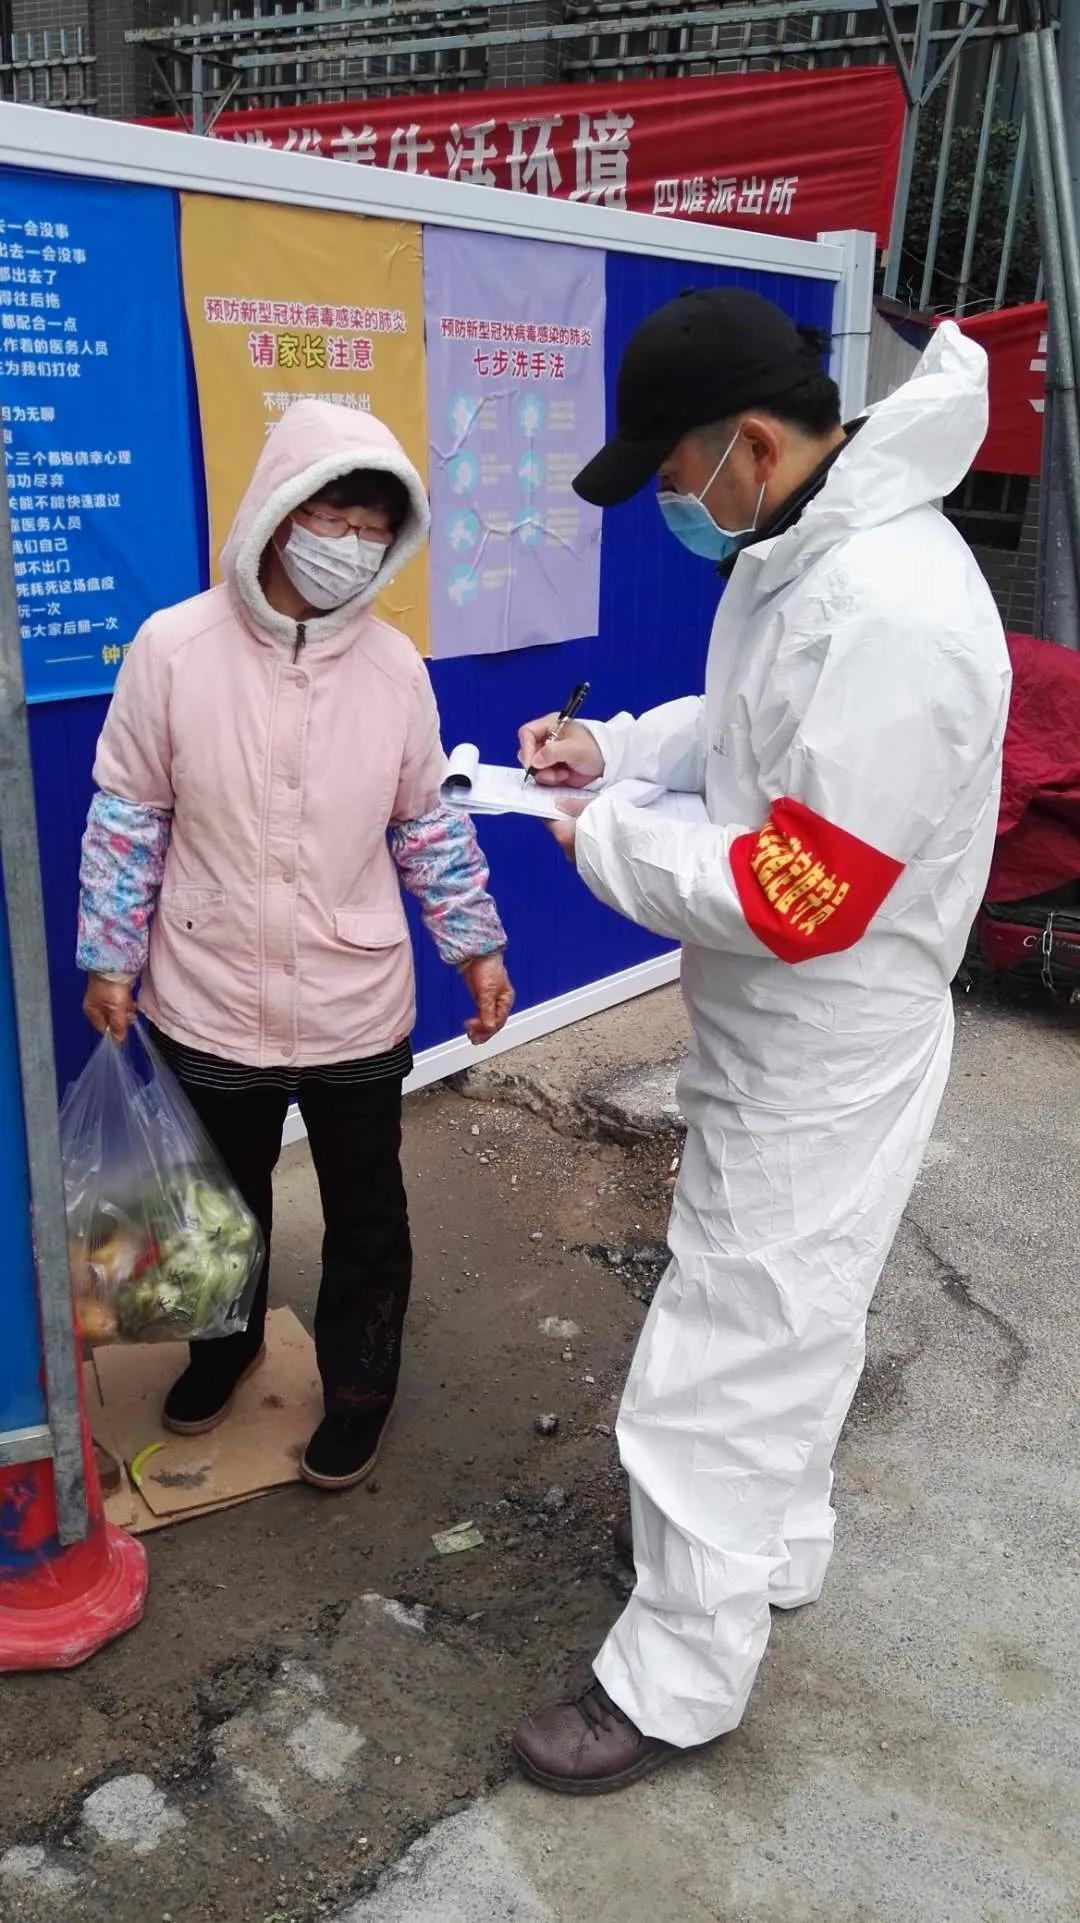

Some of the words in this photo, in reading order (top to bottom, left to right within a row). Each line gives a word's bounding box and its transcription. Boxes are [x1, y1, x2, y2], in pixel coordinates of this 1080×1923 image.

[653, 175, 799, 215] 四唯派出所
[1, 313, 78, 332] 都配合一点
[205, 296, 407, 333] 预防新型冠状病毒感染的肺炎
[0, 336, 109, 356] 作着的医务人员
[440, 317, 593, 348] 预防新型冠状病毒感染的肺炎
[249, 333, 374, 371] 请家长注意
[473, 348, 565, 379] 七步洗手法
[18, 602, 61, 618] 玩一次
